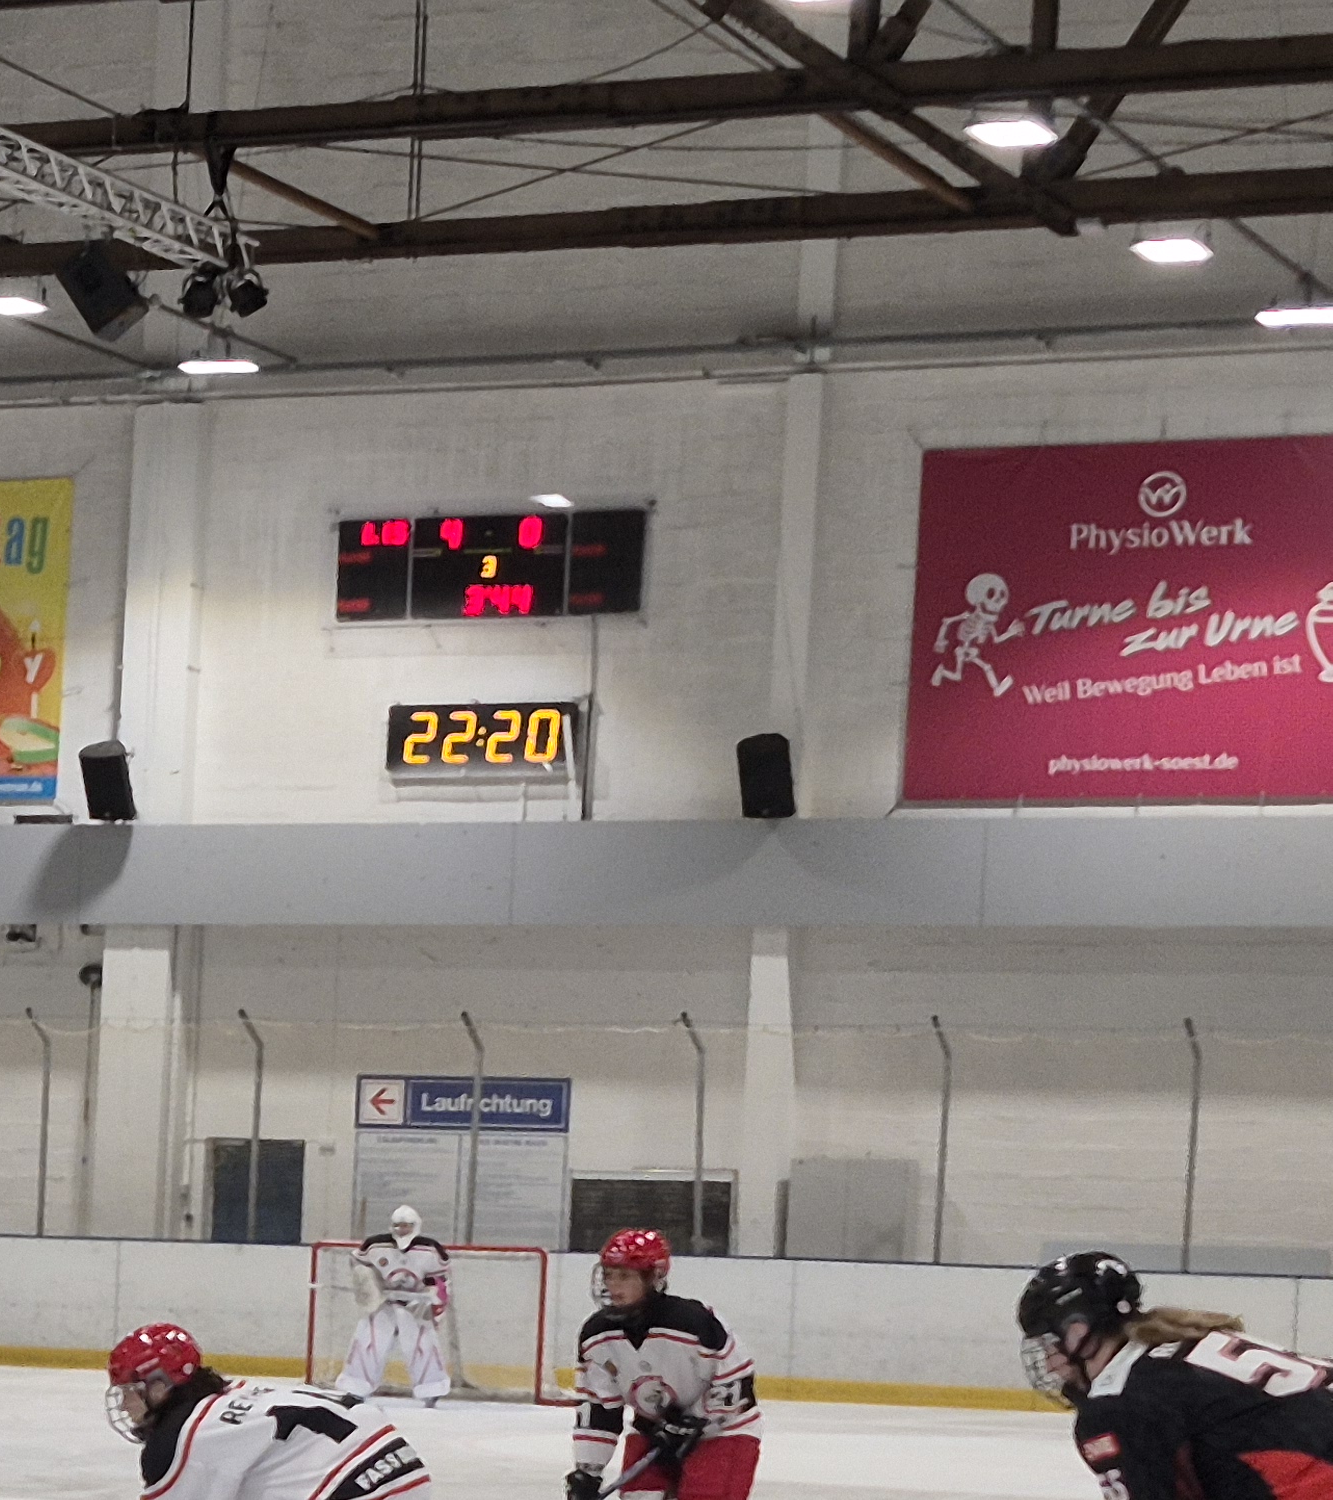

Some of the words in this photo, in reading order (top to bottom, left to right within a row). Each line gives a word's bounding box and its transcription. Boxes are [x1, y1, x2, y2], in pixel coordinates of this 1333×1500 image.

[1069, 519, 1252, 554] PhysioWerk
[1025, 599, 1135, 635] Turne
[1146, 580, 1211, 619] bis
[1120, 624, 1197, 657] zur
[1204, 611, 1299, 648] Urne
[1022, 680, 1071, 705] Weil
[1077, 668, 1194, 700] Bewegung
[1198, 659, 1268, 685] Leben
[1273, 655, 1302, 675] ist
[402, 709, 561, 764] 22:20
[1047, 753, 1239, 775] physiowerk-soest.de
[421, 1092, 553, 1118] Laufrchtung
